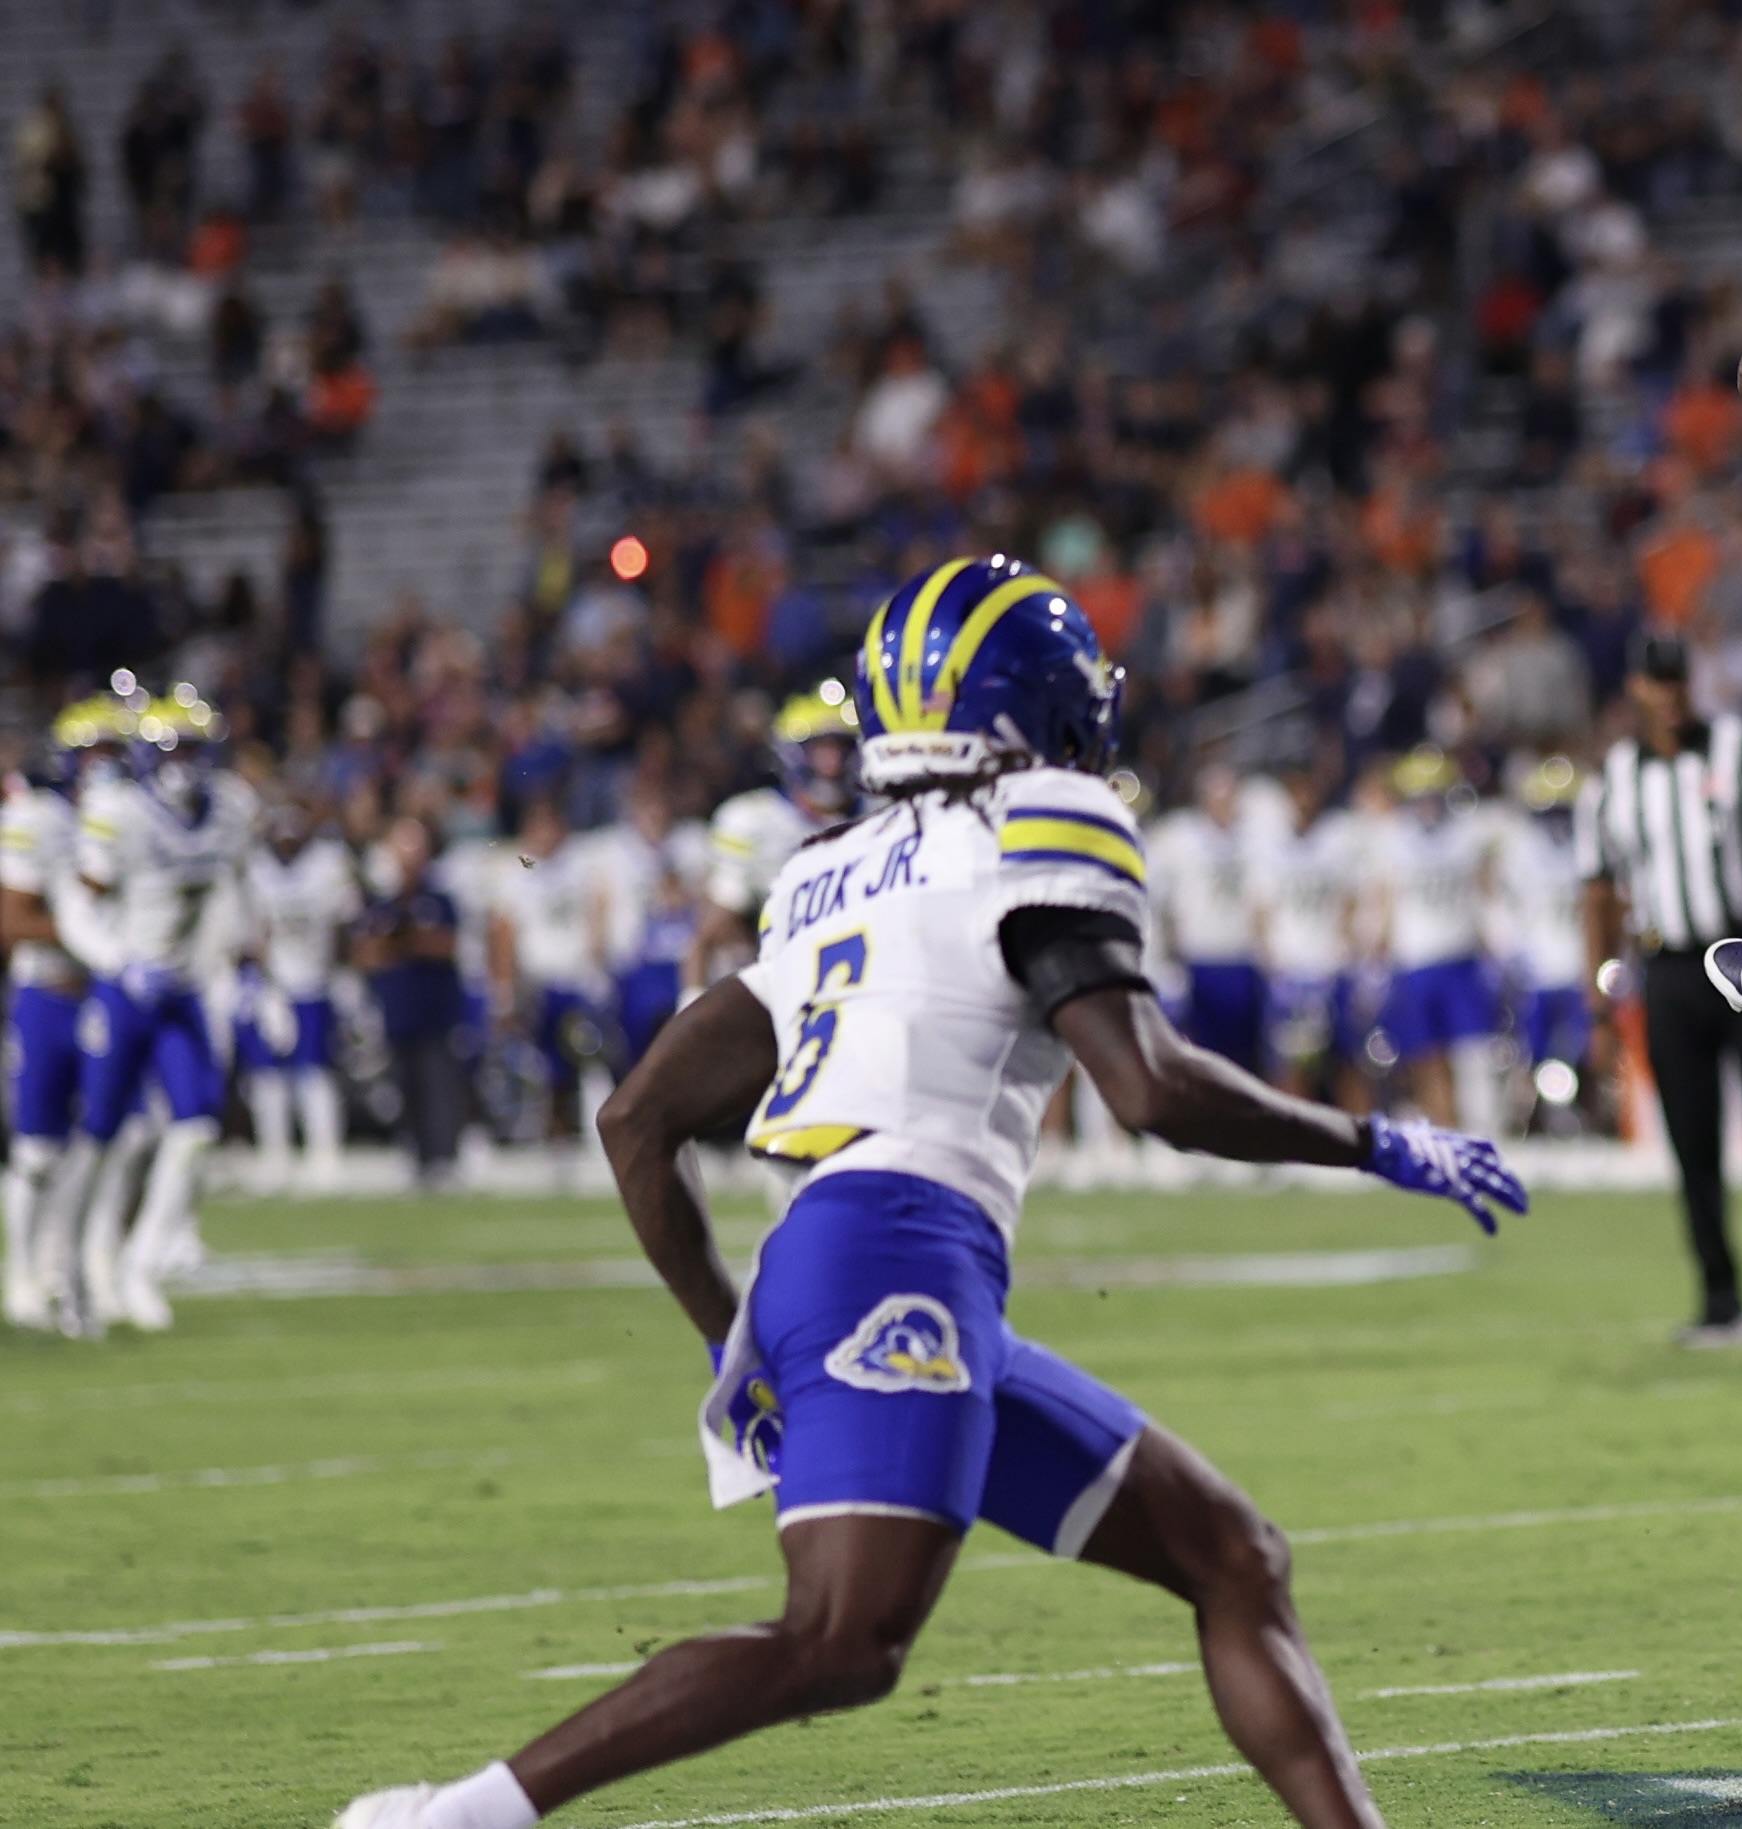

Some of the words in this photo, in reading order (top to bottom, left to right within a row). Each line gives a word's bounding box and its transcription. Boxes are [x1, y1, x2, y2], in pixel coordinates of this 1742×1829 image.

[787, 856, 863, 941] COX
[865, 832, 927, 898] JR.
[762, 928, 870, 1123] 6
